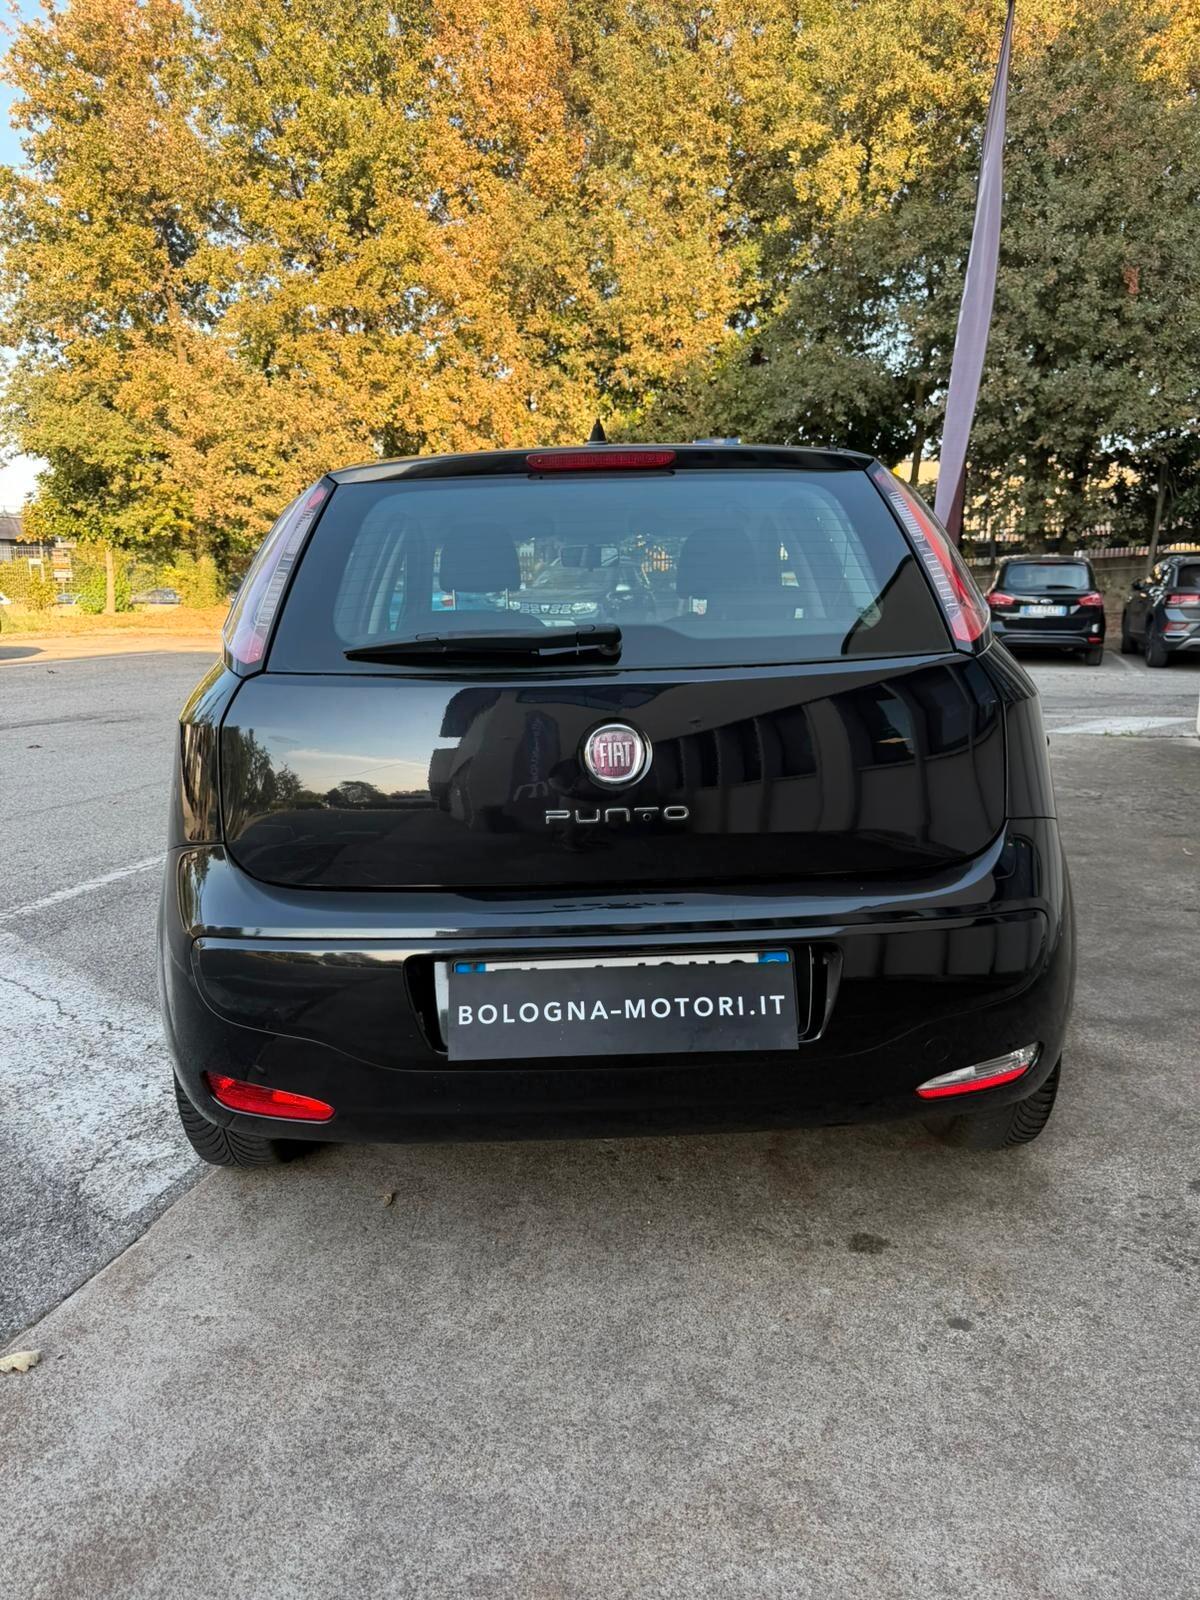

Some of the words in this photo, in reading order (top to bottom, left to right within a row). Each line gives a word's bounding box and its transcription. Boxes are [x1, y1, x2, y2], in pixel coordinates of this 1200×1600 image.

[600, 741, 633, 768] FIAT
[545, 805, 690, 825] PUNTO
[458, 994, 786, 1026] BOLOGNA-MOTORI.IT
